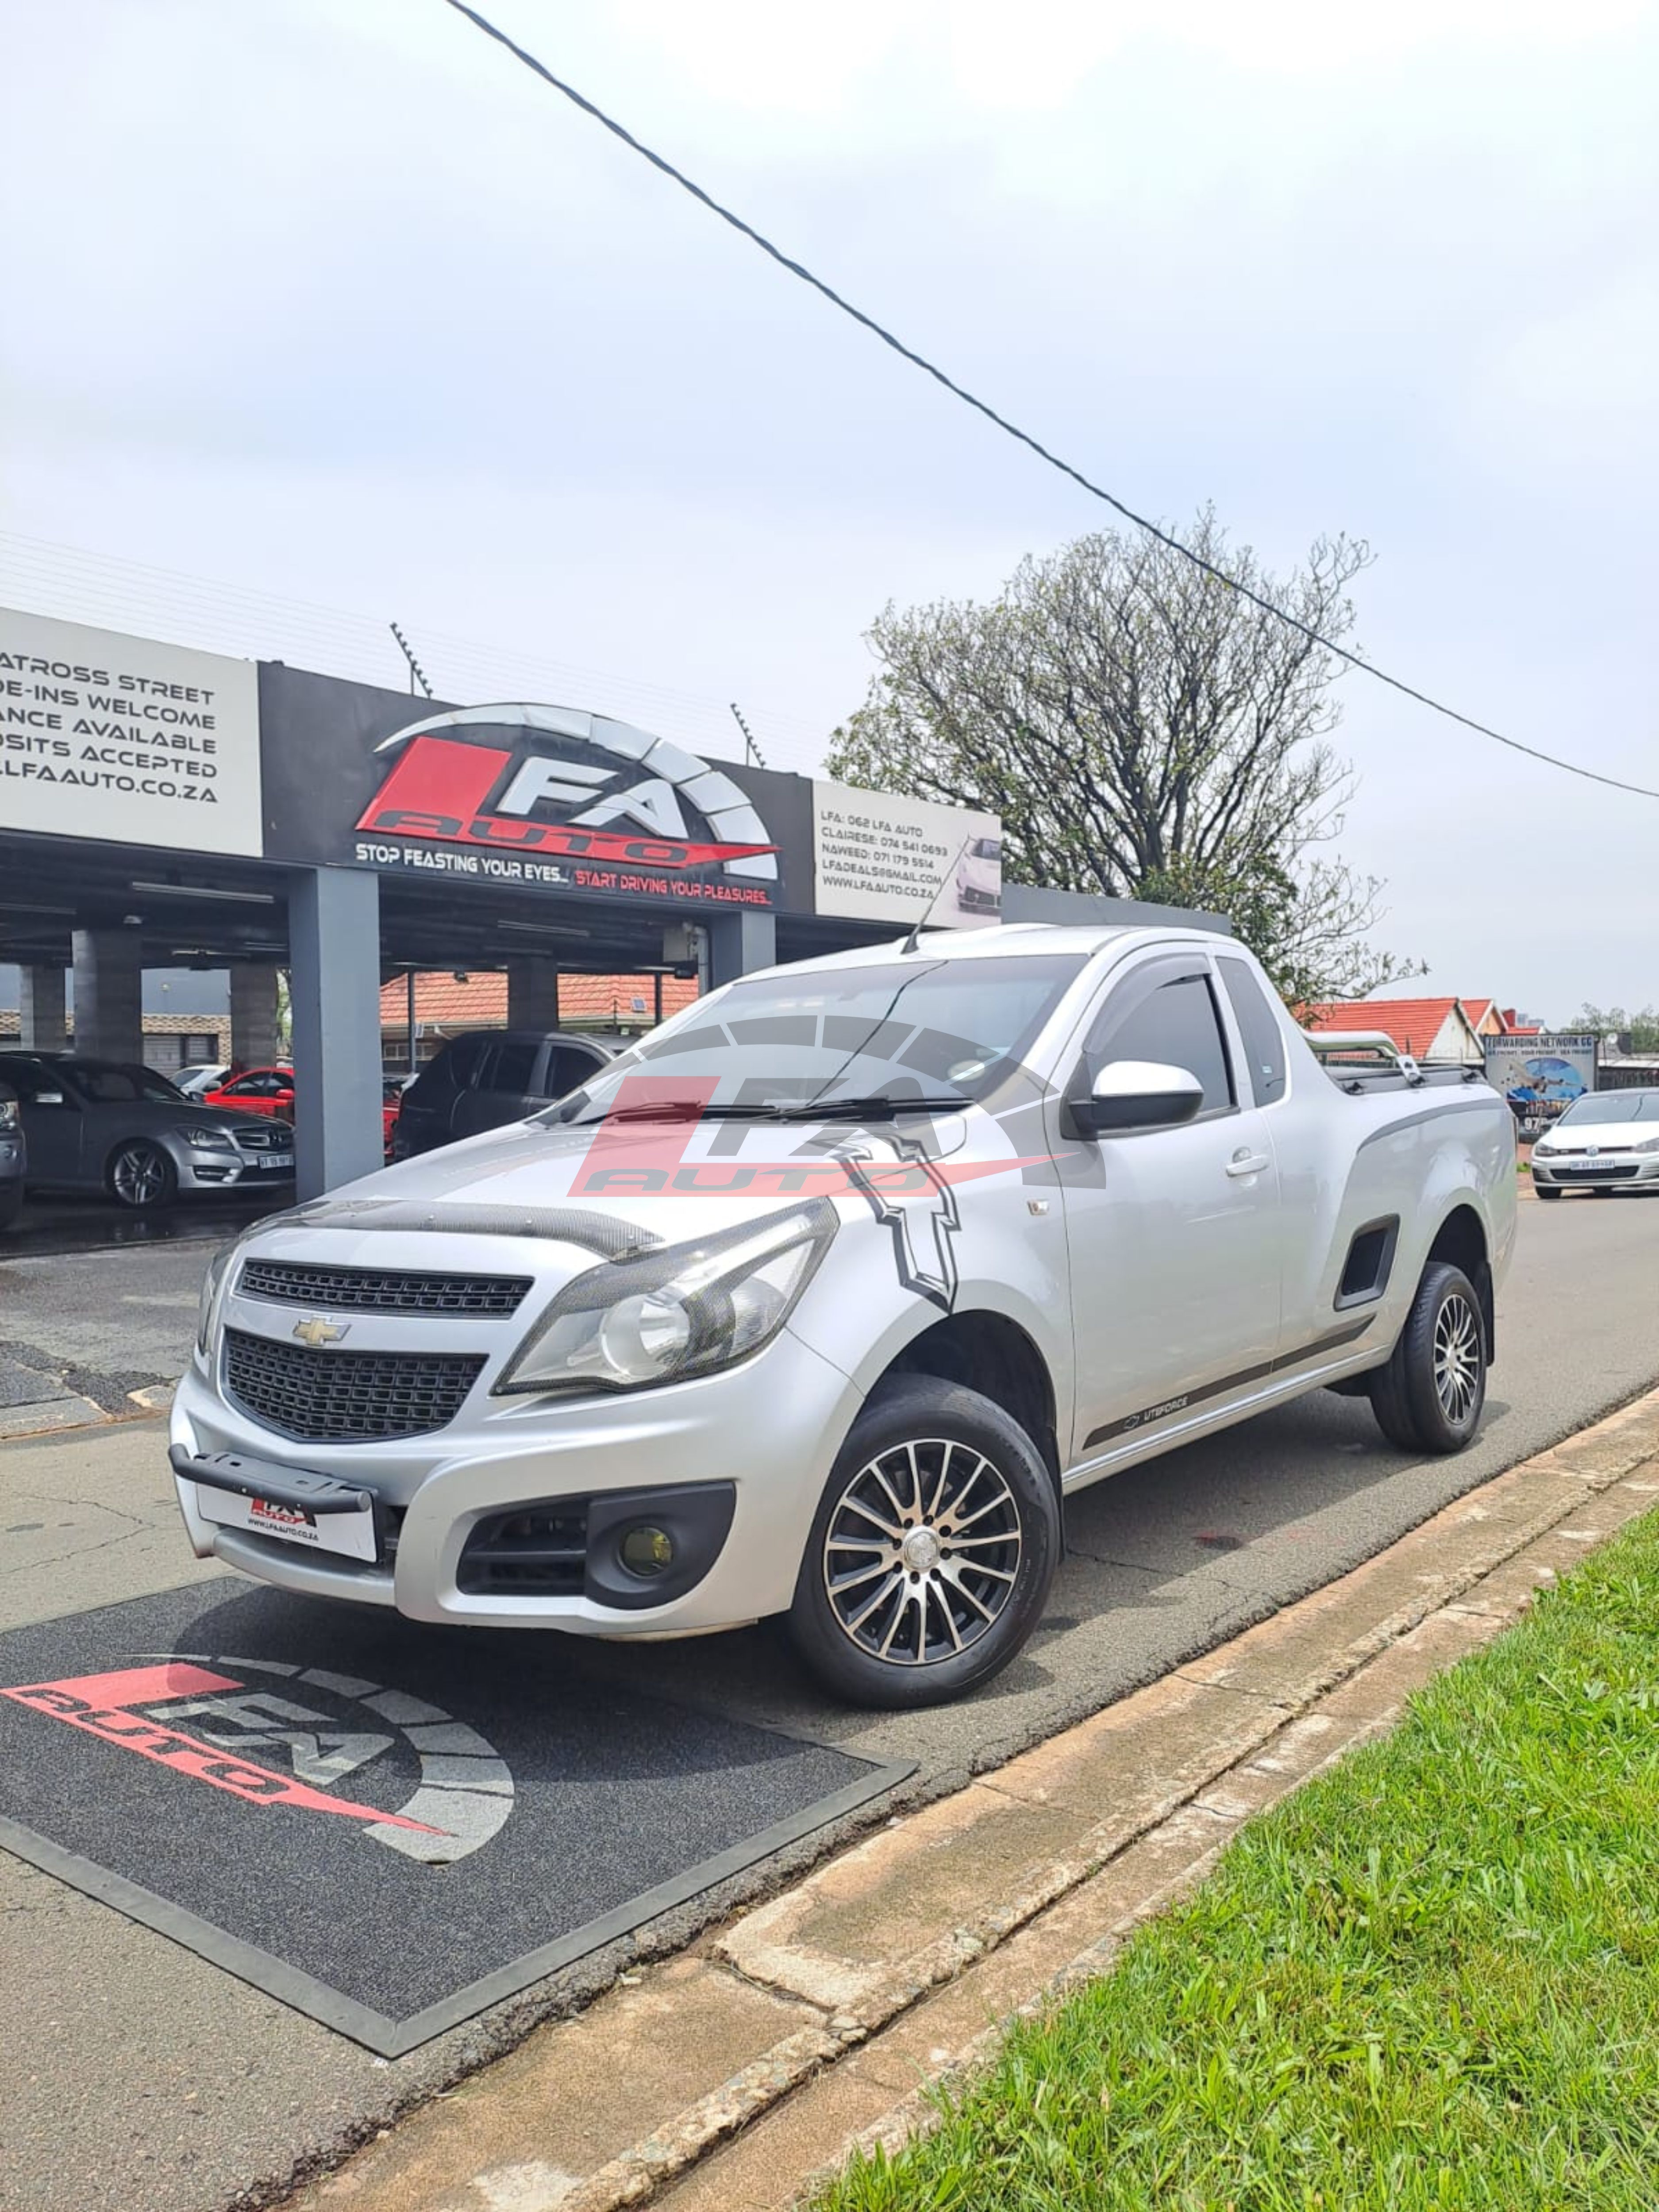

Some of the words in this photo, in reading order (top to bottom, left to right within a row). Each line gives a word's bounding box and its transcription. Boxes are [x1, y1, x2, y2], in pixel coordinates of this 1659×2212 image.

[118, 675, 215, 704] STREET
[88, 693, 216, 730] WELCOME
[72, 719, 216, 753] AVAILABLE
[0, 733, 71, 757] SITS
[80, 745, 217, 778] ACCEPTED
[373, 811, 687, 862] AUTO
[848, 816, 870, 828] 062
[872, 819, 892, 831] LFA
[895, 825, 923, 837] AUTO
[881, 837, 899, 848] 074
[903, 841, 919, 852] 541
[355, 842, 400, 863] STOP
[404, 848, 477, 873] FEASTING
[481, 858, 522, 877] YOUR
[822, 859, 943, 884] LFADEALS@GMAIL.COM
[874, 851, 890, 862] 071
[893, 854, 909, 866] 179
[912, 858, 934, 869] 5514
[575, 870, 616, 889] START
[621, 874, 667, 893] DRIVING
[670, 881, 701, 896] YOUR
[823, 876, 934, 899] WWW.LFAAUTO.CO.ZA
[1541, 1036, 1578, 1047] NETWORK
[252, 1508, 296, 1523] AUTO
[16, 1689, 293, 1794] AUTO
